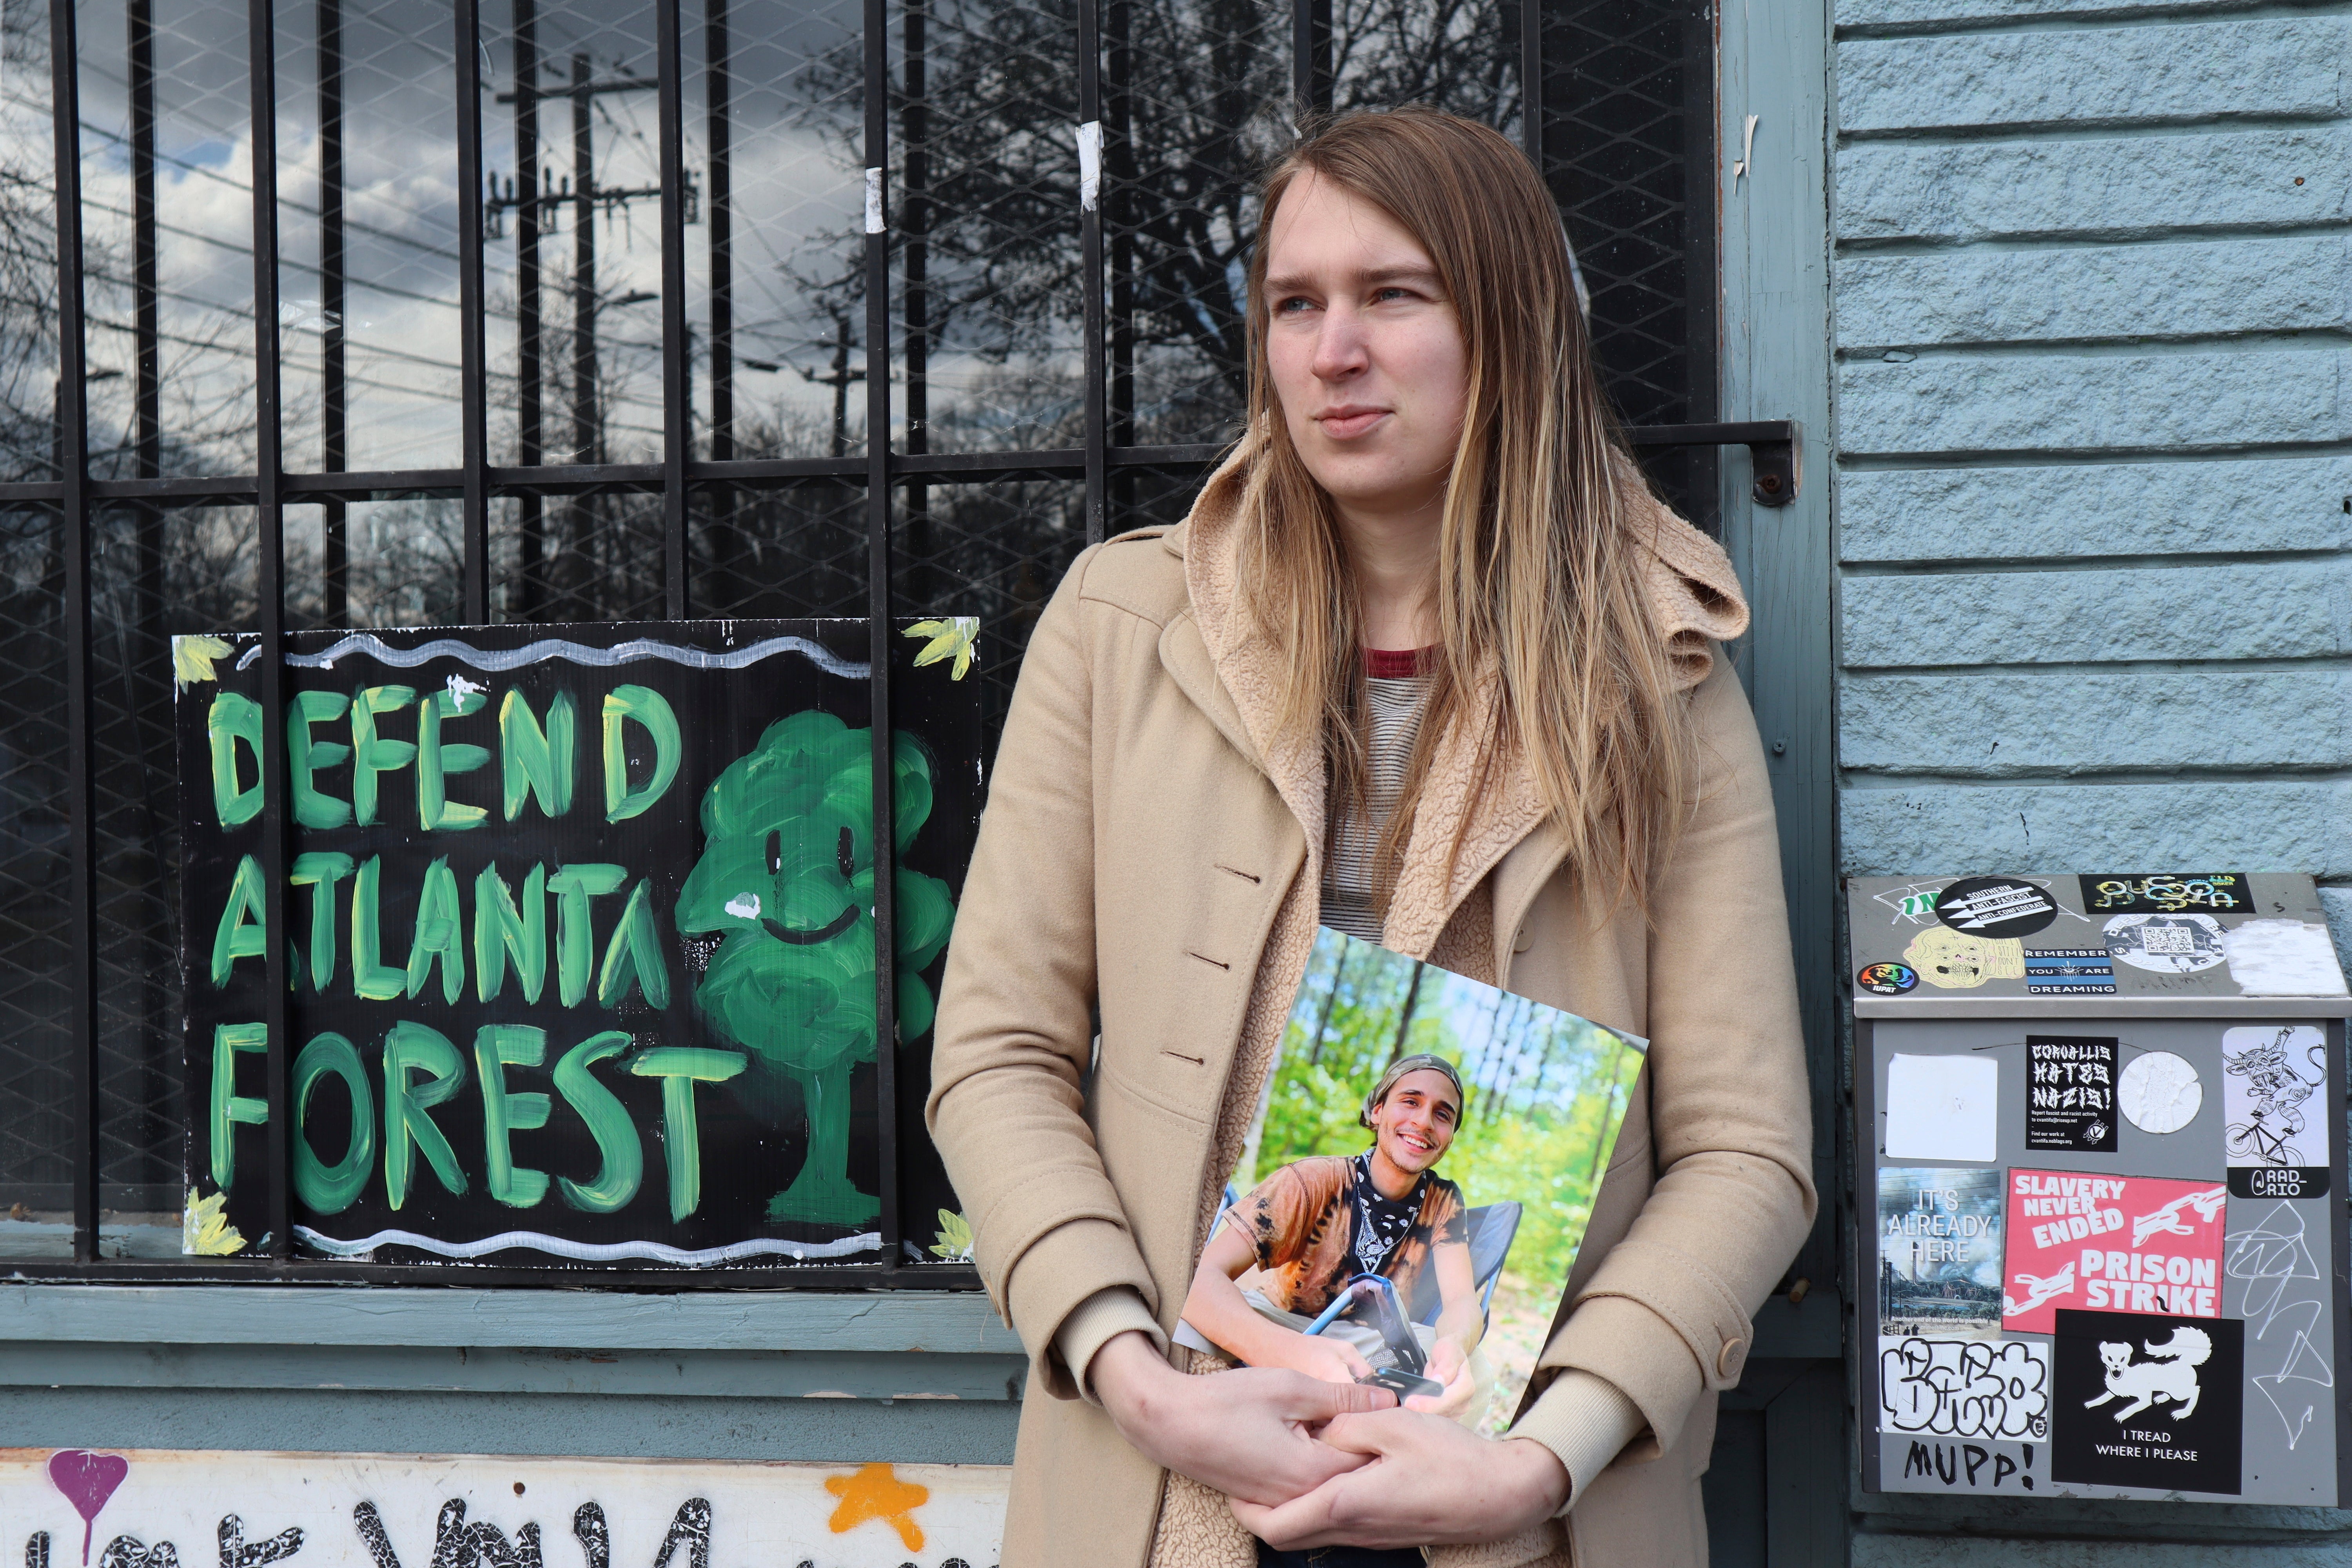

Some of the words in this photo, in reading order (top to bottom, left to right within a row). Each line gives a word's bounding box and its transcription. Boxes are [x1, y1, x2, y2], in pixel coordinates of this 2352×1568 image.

[209, 683, 682, 831] DEFEND
[1966, 885, 2013, 899] SOUTHERN
[1971, 892, 2031, 911] ANTI-FASCIST
[1978, 901, 2048, 920] ANTI-CONFEDERATE
[211, 850, 671, 1010] ATLANTA
[1998, 957, 2020, 965] DON'T
[2114, 947, 2154, 966] STOP
[2033, 1061, 2111, 1085] HATES
[2032, 1086, 2111, 1110] NAZIS!
[211, 1020, 748, 1224] FOREST
[2015, 1175, 2126, 1200] SLAVERY
[2267, 1183, 2300, 1196] RIO
[1919, 1189, 1959, 1211] IT'S
[2024, 1196, 2096, 1216] NEVER
[1888, 1214, 1991, 1237] ALREADY
[2032, 1208, 2124, 1249] ENDED
[1910, 1240, 1969, 1262] HERE
[2080, 1249, 2216, 1287] PRISON
[2086, 1279, 2216, 1317] STRIKE
[2123, 1430, 2126, 1440] I
[2131, 1430, 2171, 1443] TREAD
[2095, 1444, 2141, 1457] WHERE
[2146, 1448, 2149, 1458] I
[2154, 1448, 2198, 1461] PLEASE
